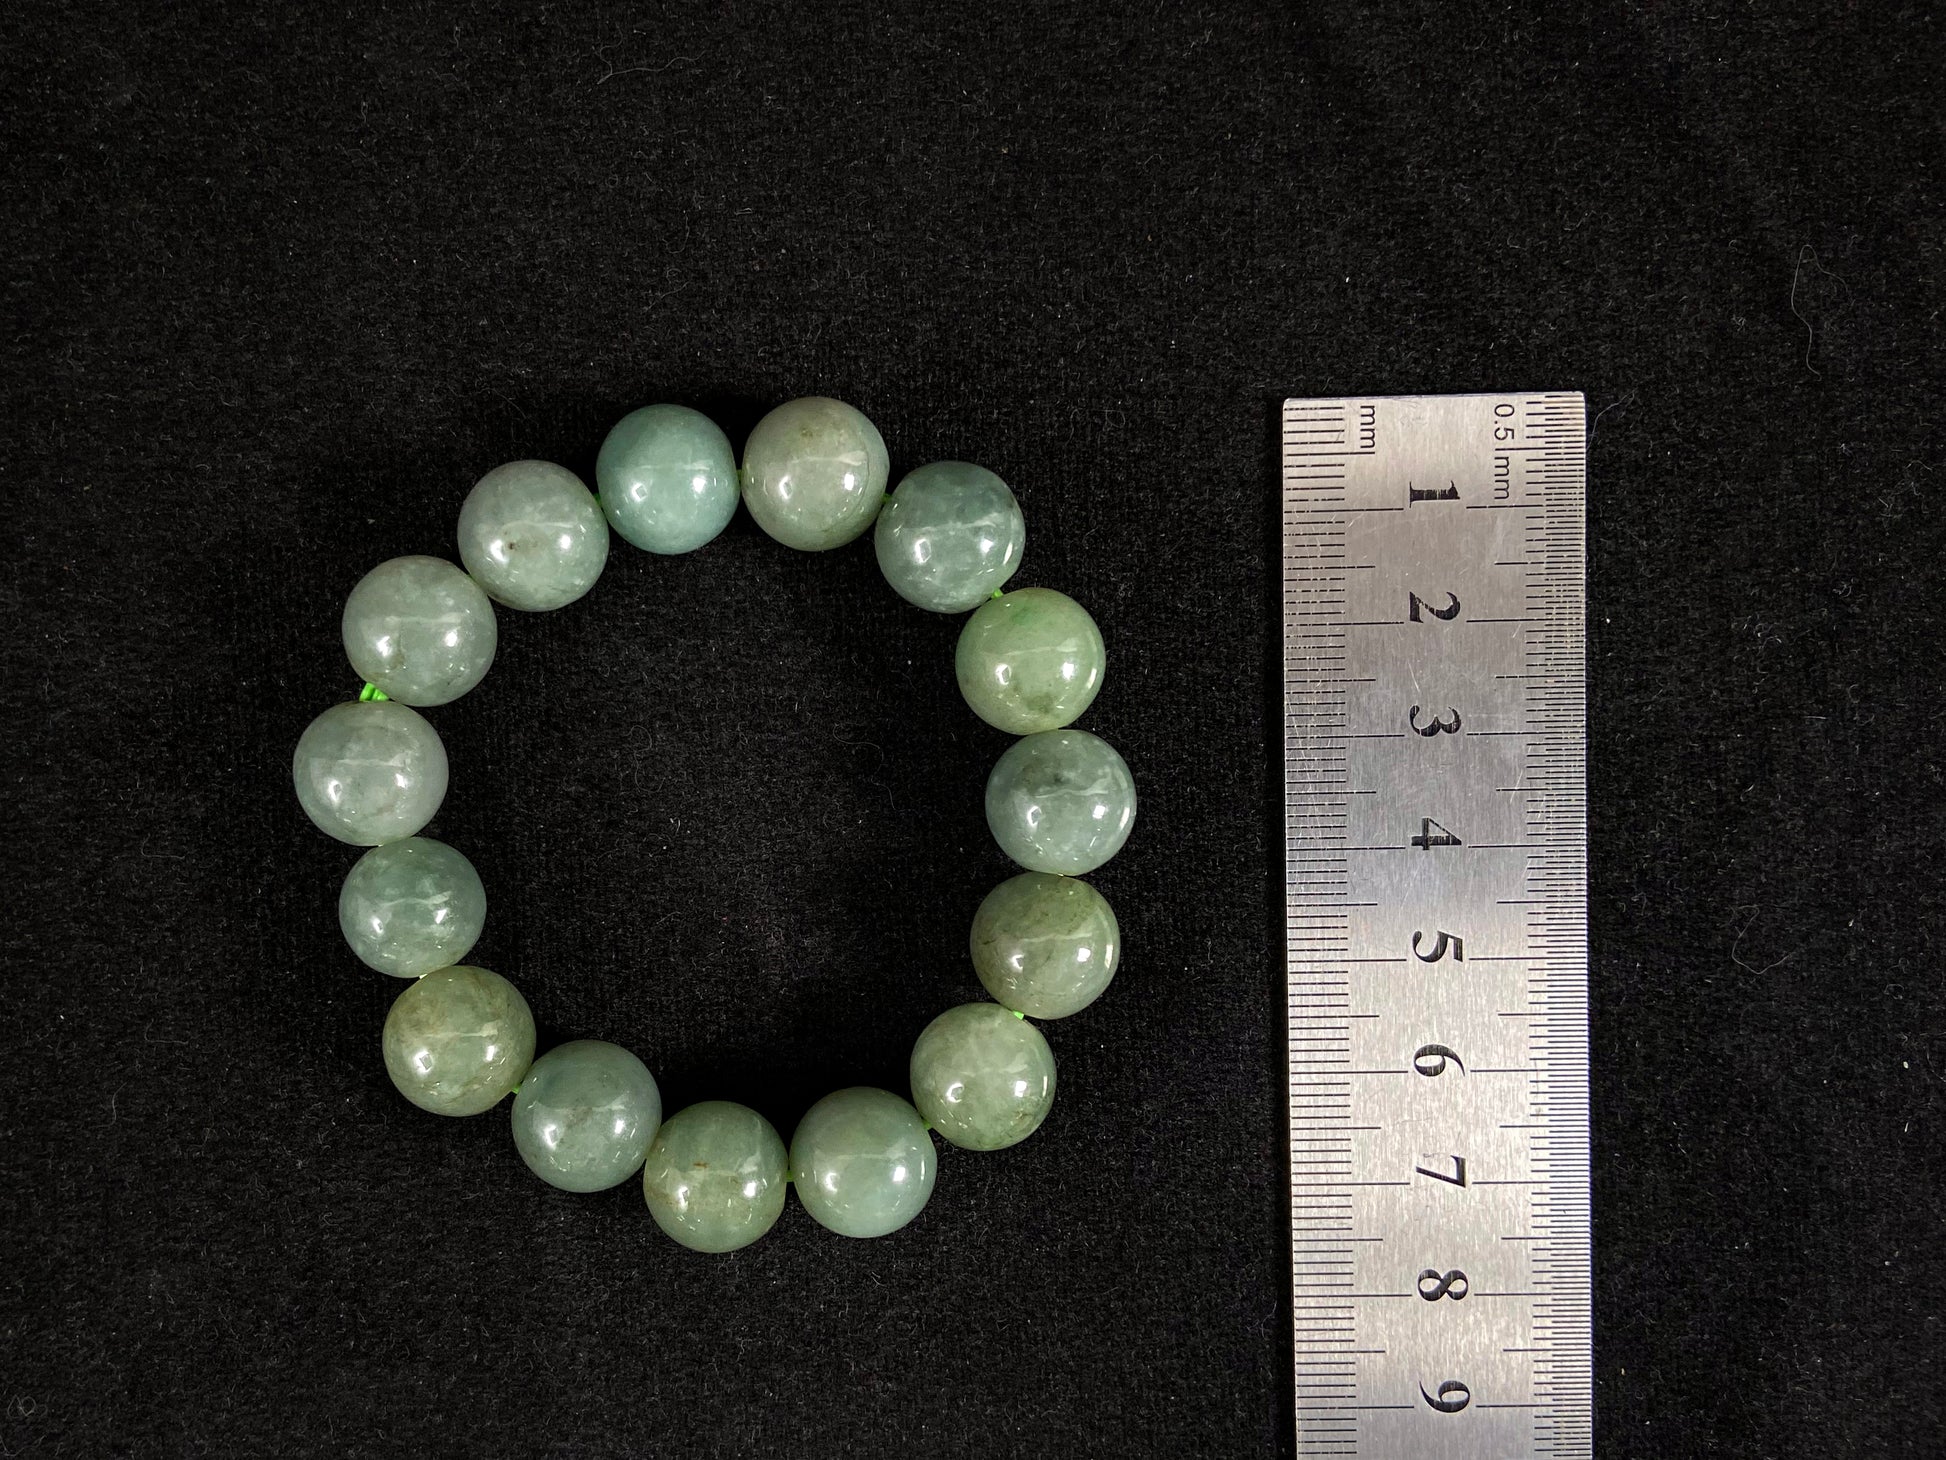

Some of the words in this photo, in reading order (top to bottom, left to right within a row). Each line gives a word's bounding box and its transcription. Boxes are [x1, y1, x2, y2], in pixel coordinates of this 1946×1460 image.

[1360, 405, 1375, 448] mm
[1409, 480, 1460, 508] 1
[1409, 591, 1461, 623] 2
[1409, 705, 1462, 737] 3
[1411, 817, 1462, 850] 4
[1412, 930, 1463, 962] 5
[1413, 1043, 1465, 1077] 6
[1415, 1155, 1466, 1188] 7
[1417, 1268, 1468, 1301] 8
[1419, 1379, 1470, 1413] 9
